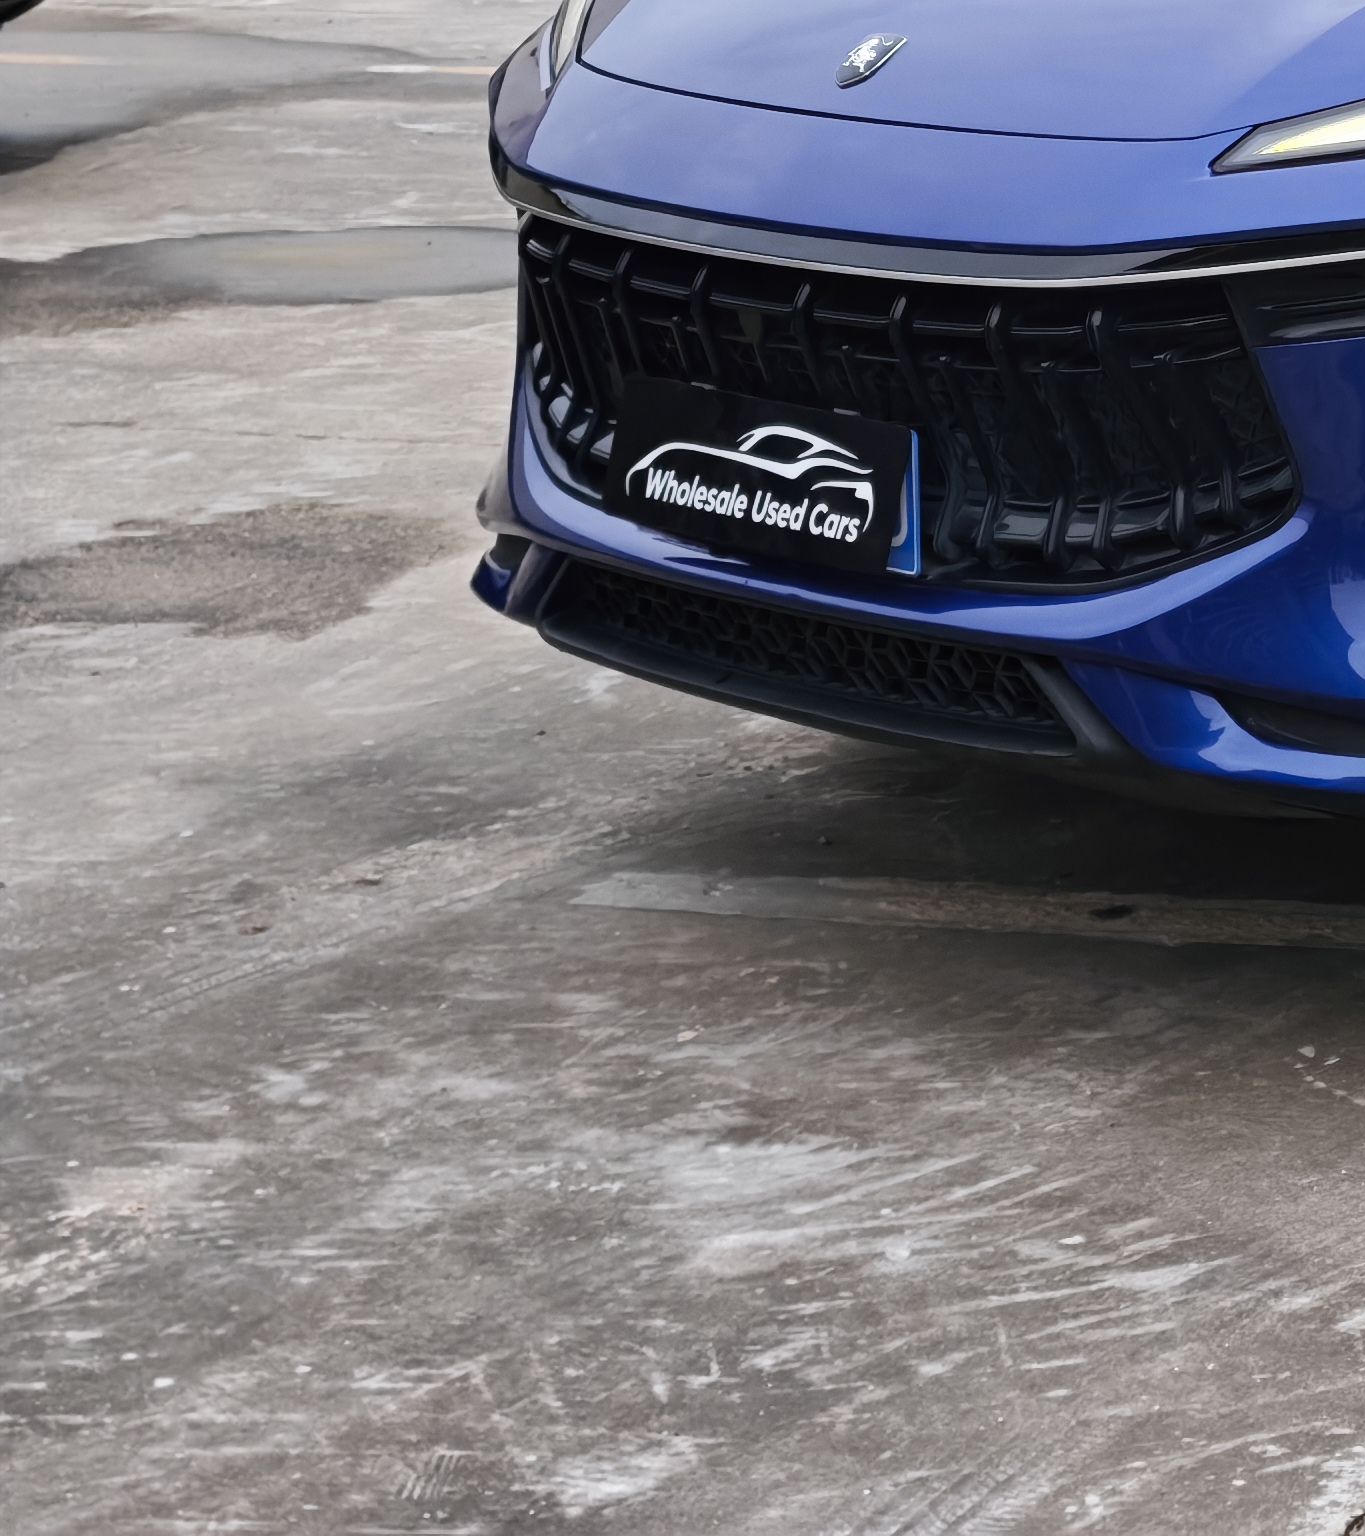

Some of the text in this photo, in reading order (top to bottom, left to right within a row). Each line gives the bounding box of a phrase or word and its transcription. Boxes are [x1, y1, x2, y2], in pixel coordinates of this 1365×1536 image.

[645, 467, 861, 543] Wholesale Used Cars
